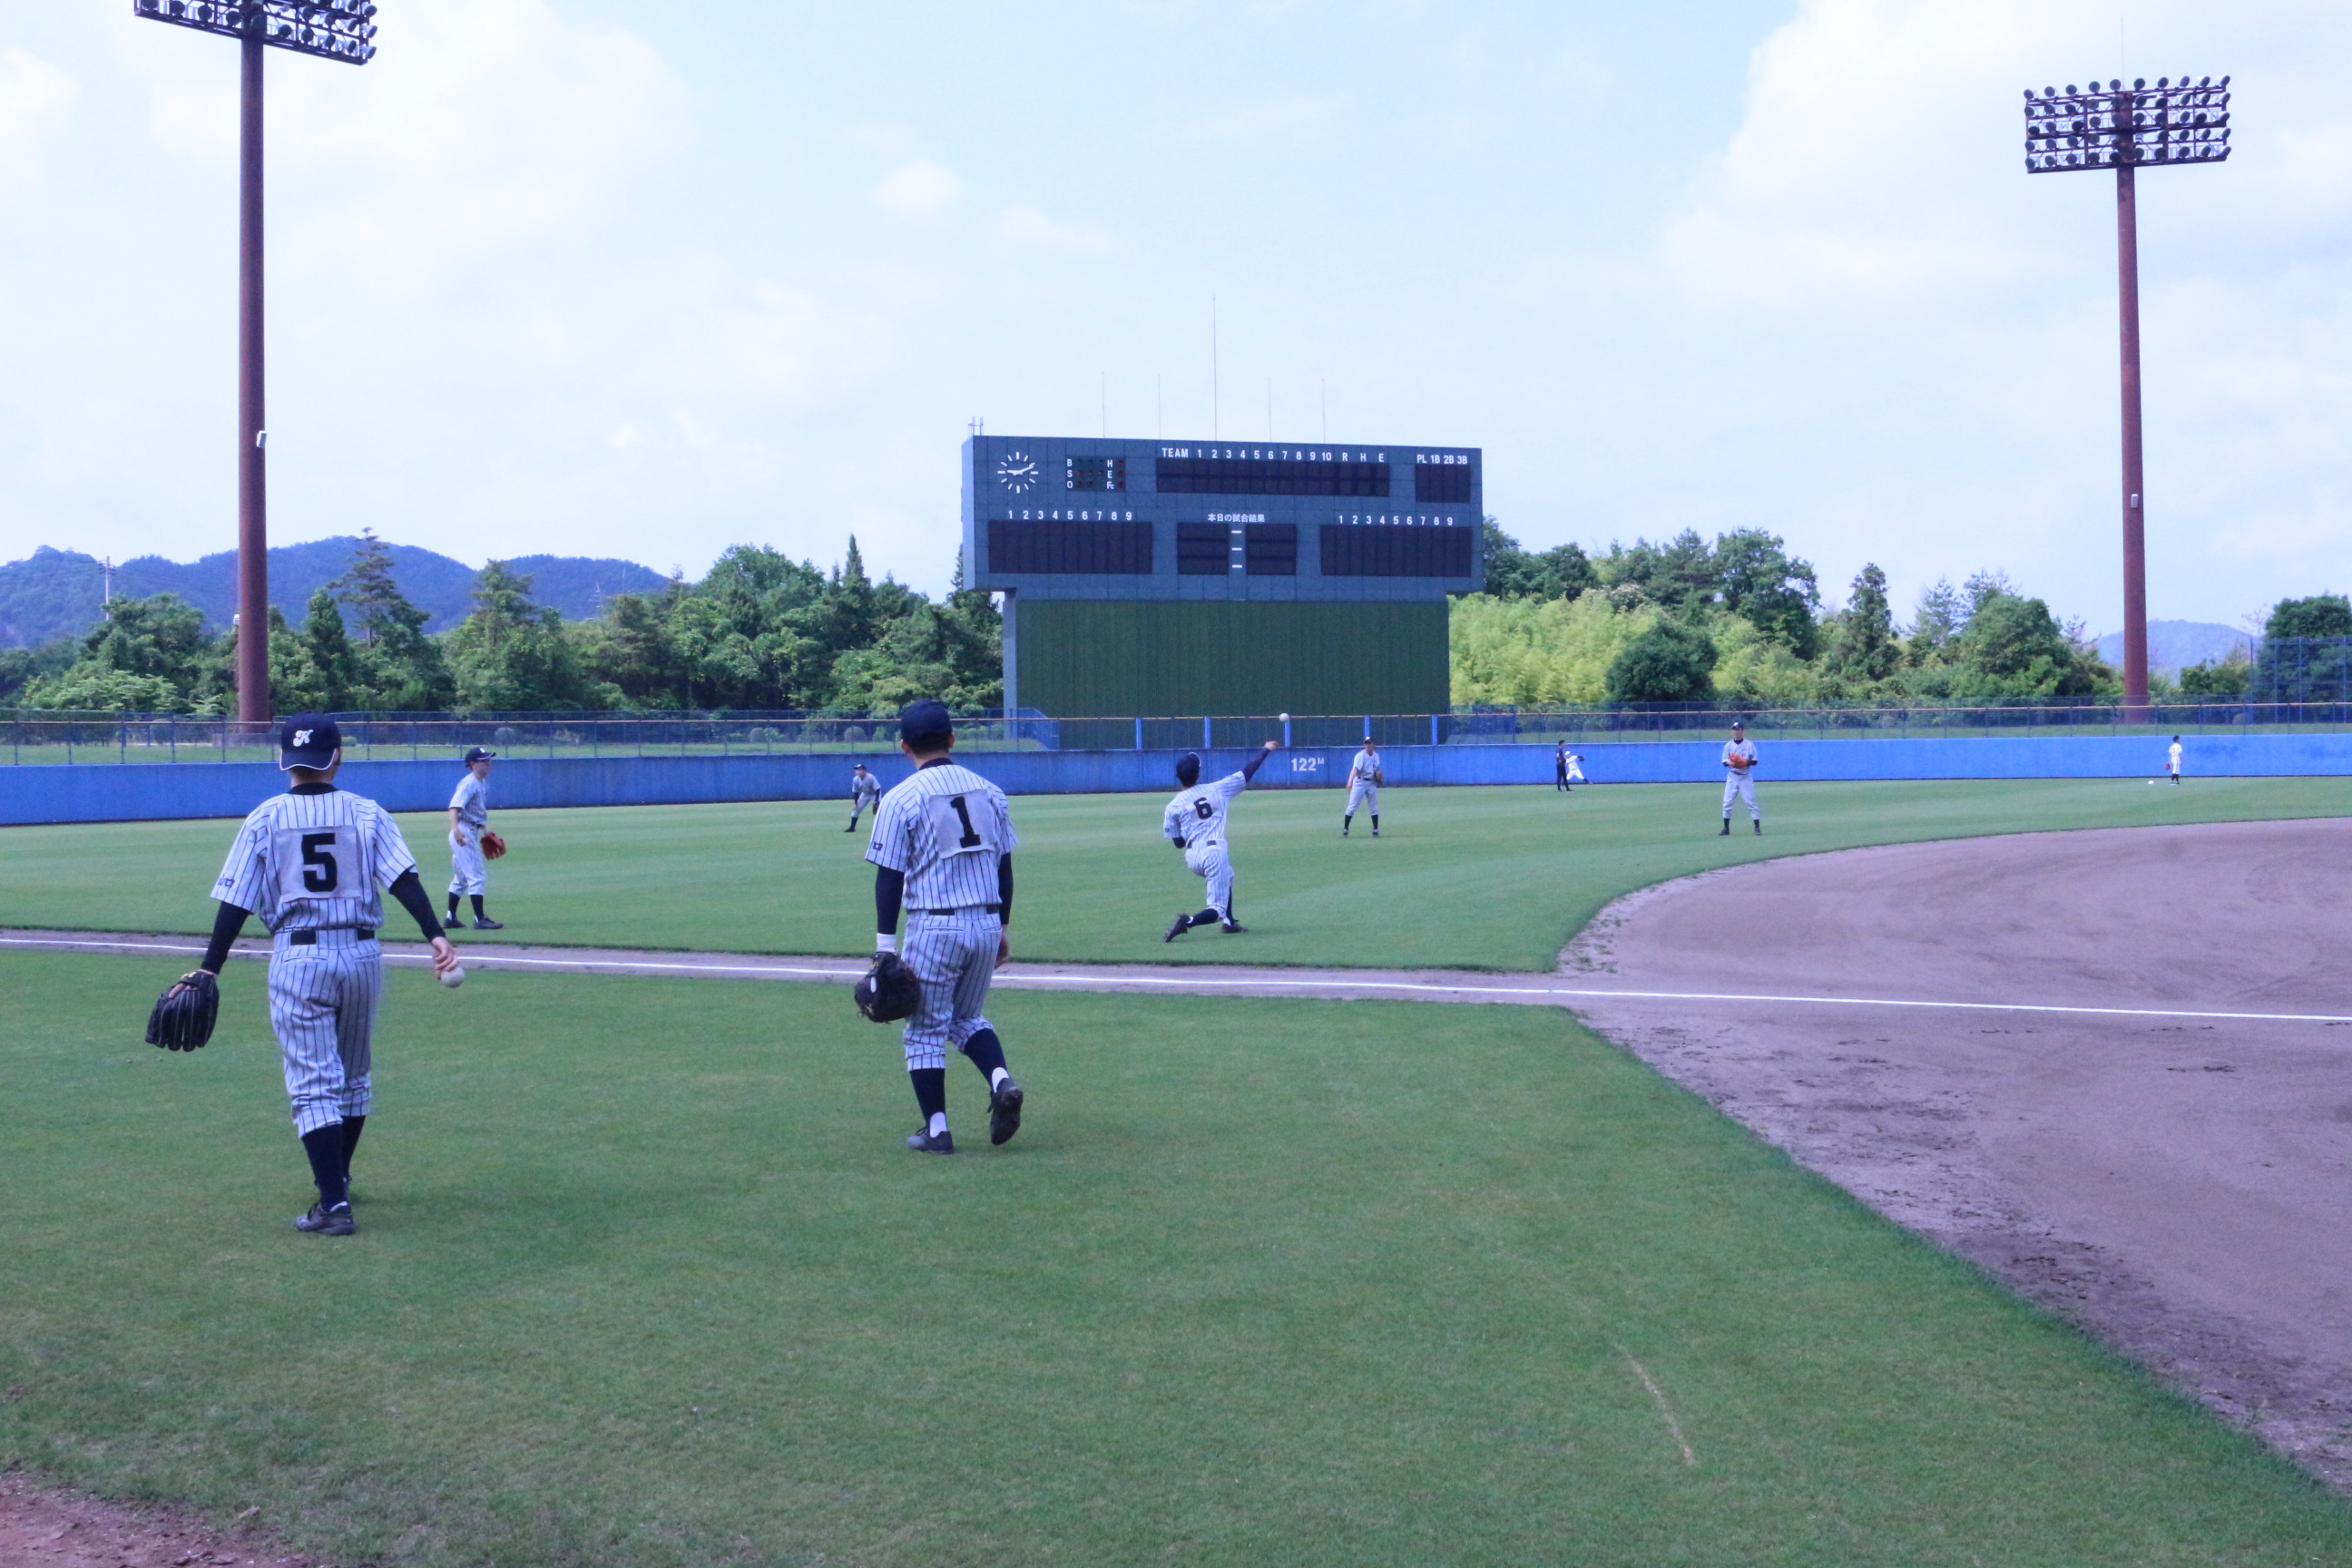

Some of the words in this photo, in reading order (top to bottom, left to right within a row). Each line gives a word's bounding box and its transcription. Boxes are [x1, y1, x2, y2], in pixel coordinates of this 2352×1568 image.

[1161, 447, 1189, 458] TEAM
[1198, 448, 1202, 458] 1
[1211, 448, 1218, 459] 2
[1226, 449, 1232, 459] 3
[1240, 449, 1247, 459] 4
[1253, 449, 1260, 459] 5
[1267, 450, 1274, 460] 6
[1281, 450, 1289, 460] 7
[1296, 451, 1302, 461] 8
[1309, 451, 1317, 461] 9
[1321, 451, 1332, 461] 10
[1342, 452, 1348, 462] R
[1360, 452, 1367, 462] H
[1378, 453, 1385, 463] E
[1416, 454, 1427, 464] PL
[1430, 454, 1441, 465] 1B
[1443, 455, 1455, 465] 2B
[1456, 455, 1468, 465] 3B
[1066, 458, 1073, 467] B
[1106, 459, 1113, 468] H
[1066, 469, 1073, 478] S
[1107, 470, 1112, 479] E
[1008, 509, 1014, 520] 1
[1023, 509, 1029, 520] 2
[1037, 510, 1044, 520] 3
[1052, 510, 1059, 520] 4
[1067, 510, 1073, 520] 5
[1082, 510, 1089, 521] 6
[1096, 511, 1102, 521] 7
[1111, 511, 1118, 521] 8
[1125, 511, 1132, 521] 9
[1208, 513, 1265, 523] 本日の試合結果
[1338, 514, 1343, 524] 1
[1352, 514, 1358, 524] 2
[1366, 514, 1372, 524] 3
[1379, 515, 1387, 524] 4
[1393, 515, 1399, 525] 5
[1406, 515, 1413, 525] 6
[1420, 515, 1426, 525] 7
[1434, 516, 1440, 525] 8
[1446, 516, 1454, 526] 9
[1193, 797, 1213, 819] 6
[949, 796, 982, 848] 1
[300, 832, 338, 893] 5
